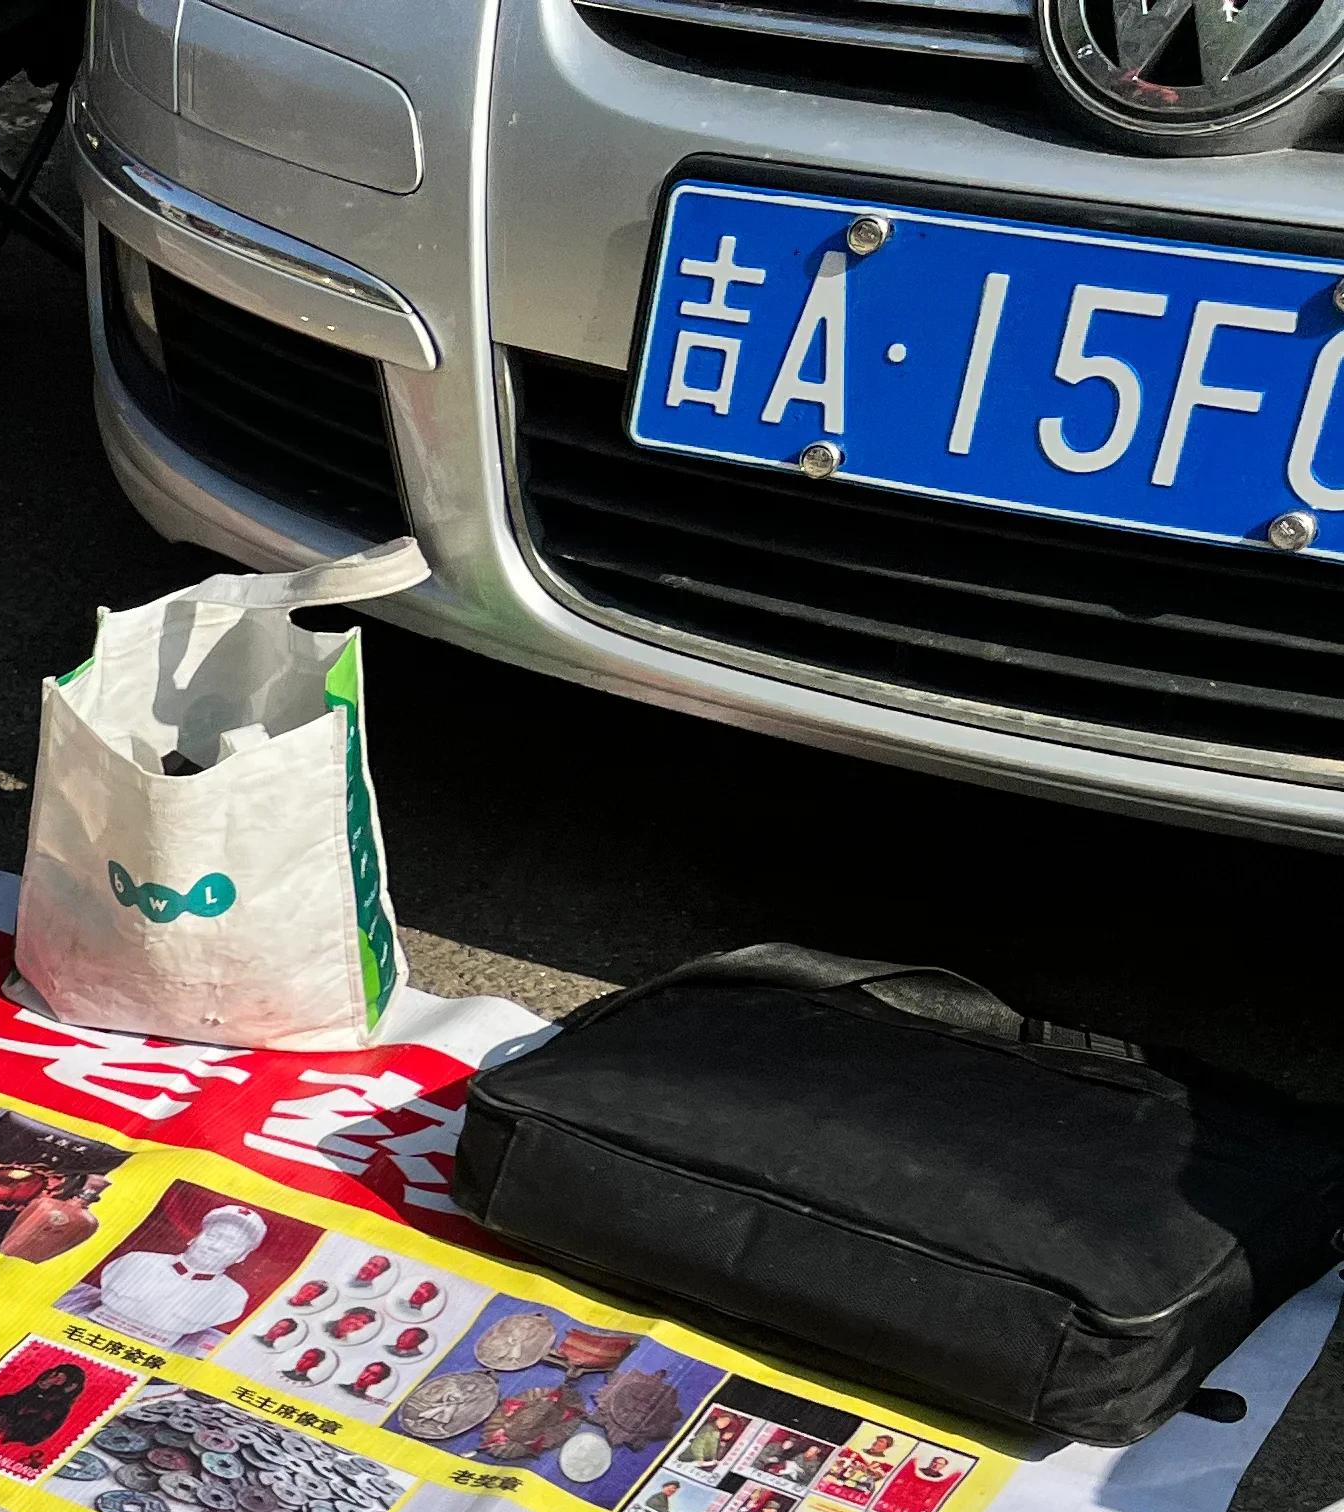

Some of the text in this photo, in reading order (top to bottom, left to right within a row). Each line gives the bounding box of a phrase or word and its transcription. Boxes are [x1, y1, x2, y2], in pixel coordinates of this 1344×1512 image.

[62, 1325, 167, 1370] 毛主席瓷像
[230, 1387, 342, 1434] 毛主席像章
[447, 1461, 524, 1501] 老奖章
